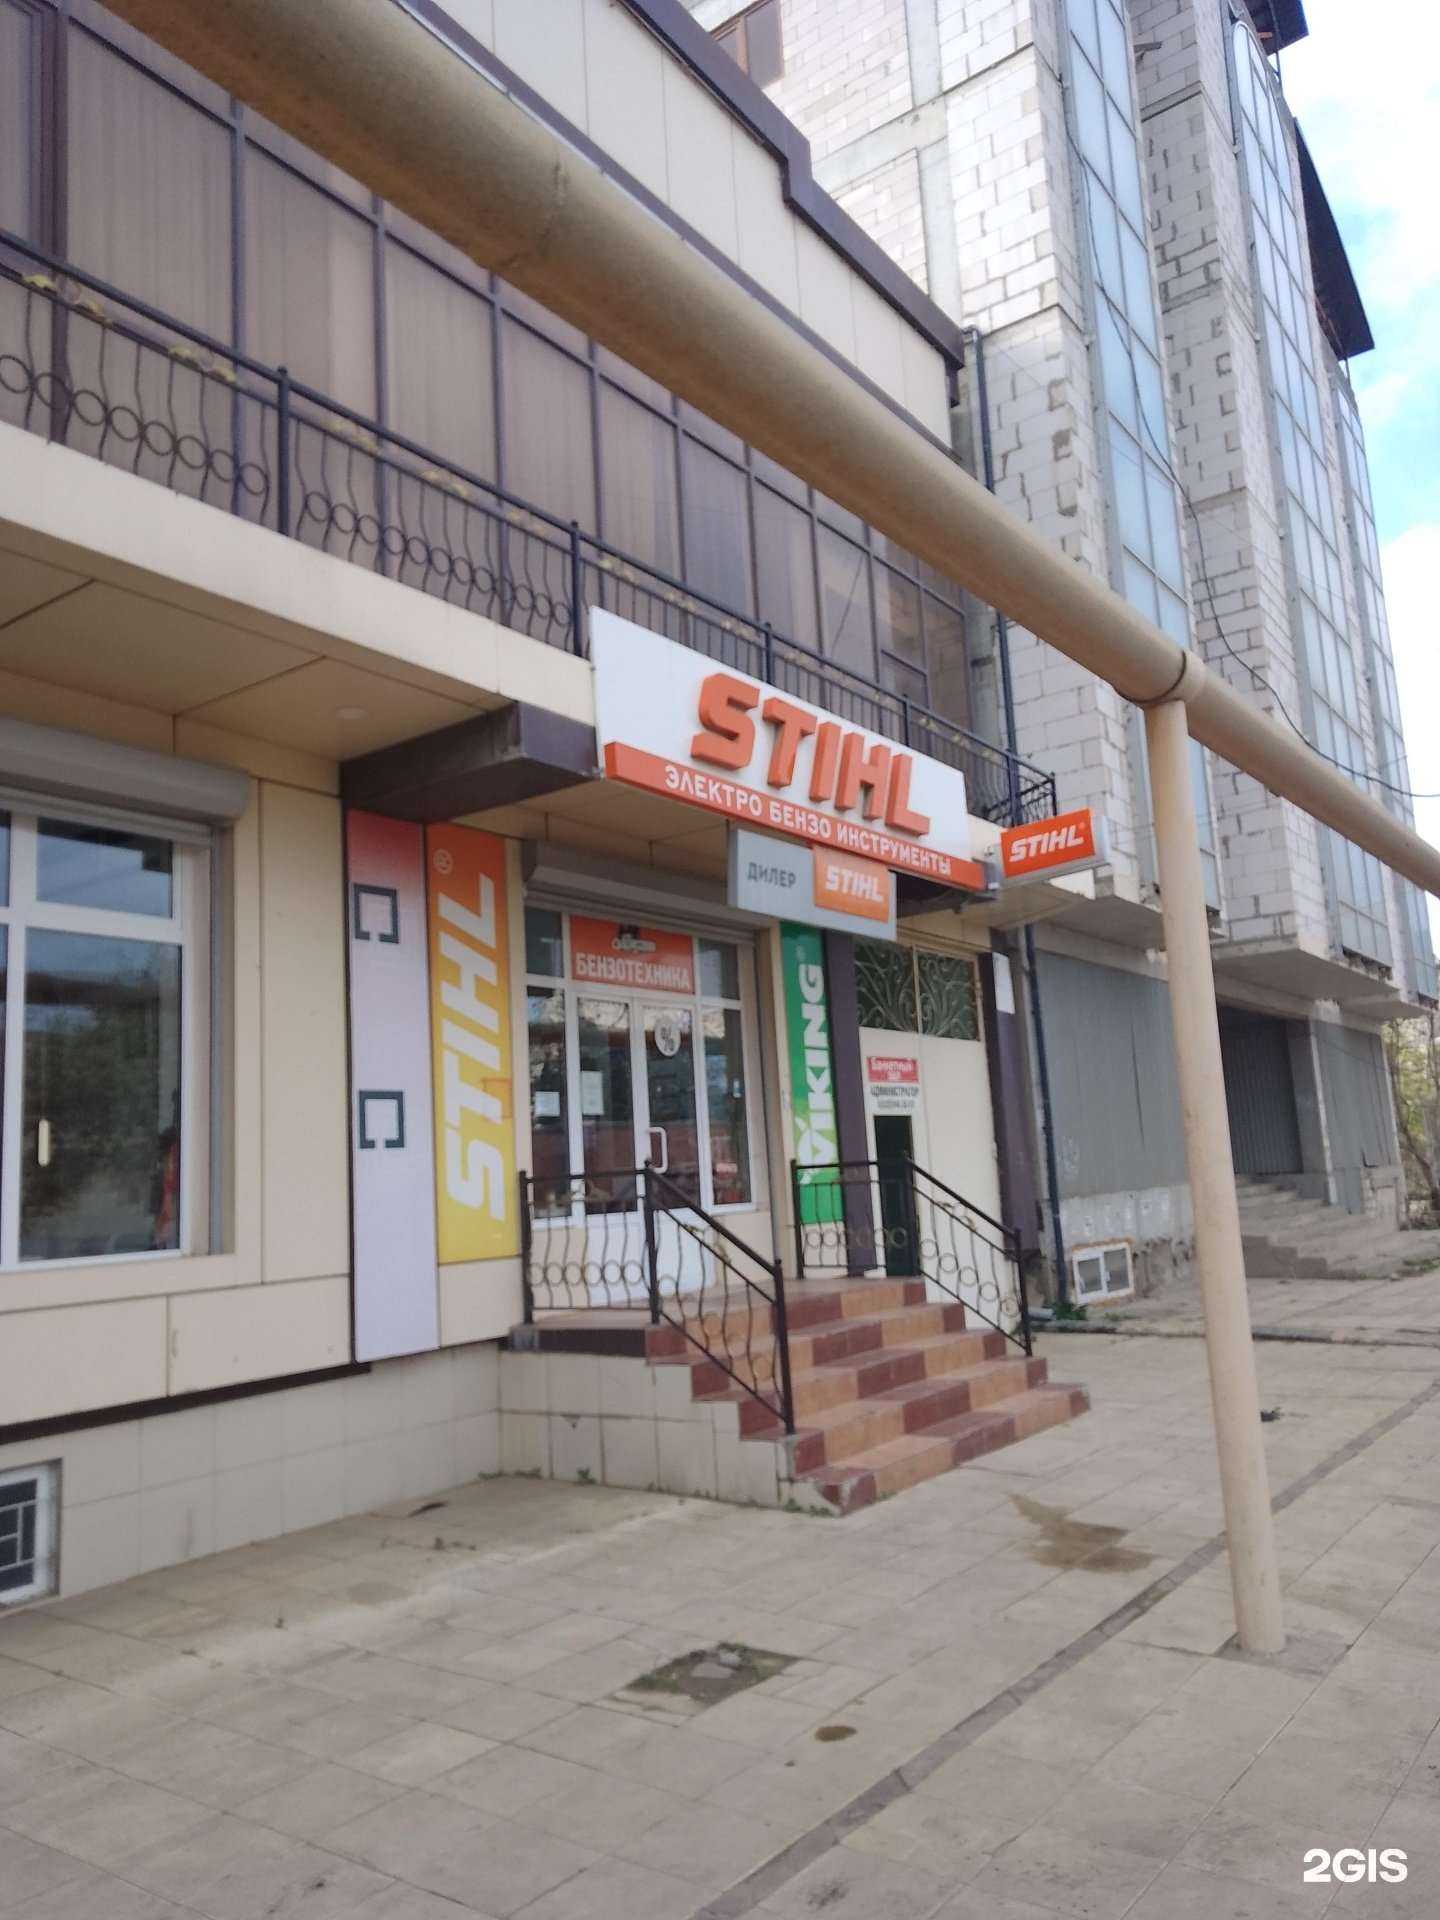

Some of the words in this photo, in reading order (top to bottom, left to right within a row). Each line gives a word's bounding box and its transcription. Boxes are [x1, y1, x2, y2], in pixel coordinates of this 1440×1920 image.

[690, 673, 930, 836] STIHL
[664, 765, 763, 816] ЭЛЕКТРО
[769, 800, 832, 838] БЕНЗО
[837, 823, 951, 875] ИНСТРУМЕНТЫ
[1009, 824, 1084, 862] STIHL
[747, 862, 796, 888] ДИЛЕР
[825, 864, 883, 902] STIHL
[576, 952, 690, 990] БЕНЗОТЕХНИКА
[437, 873, 505, 1220] STIHL
[797, 963, 839, 1184] VIKING
